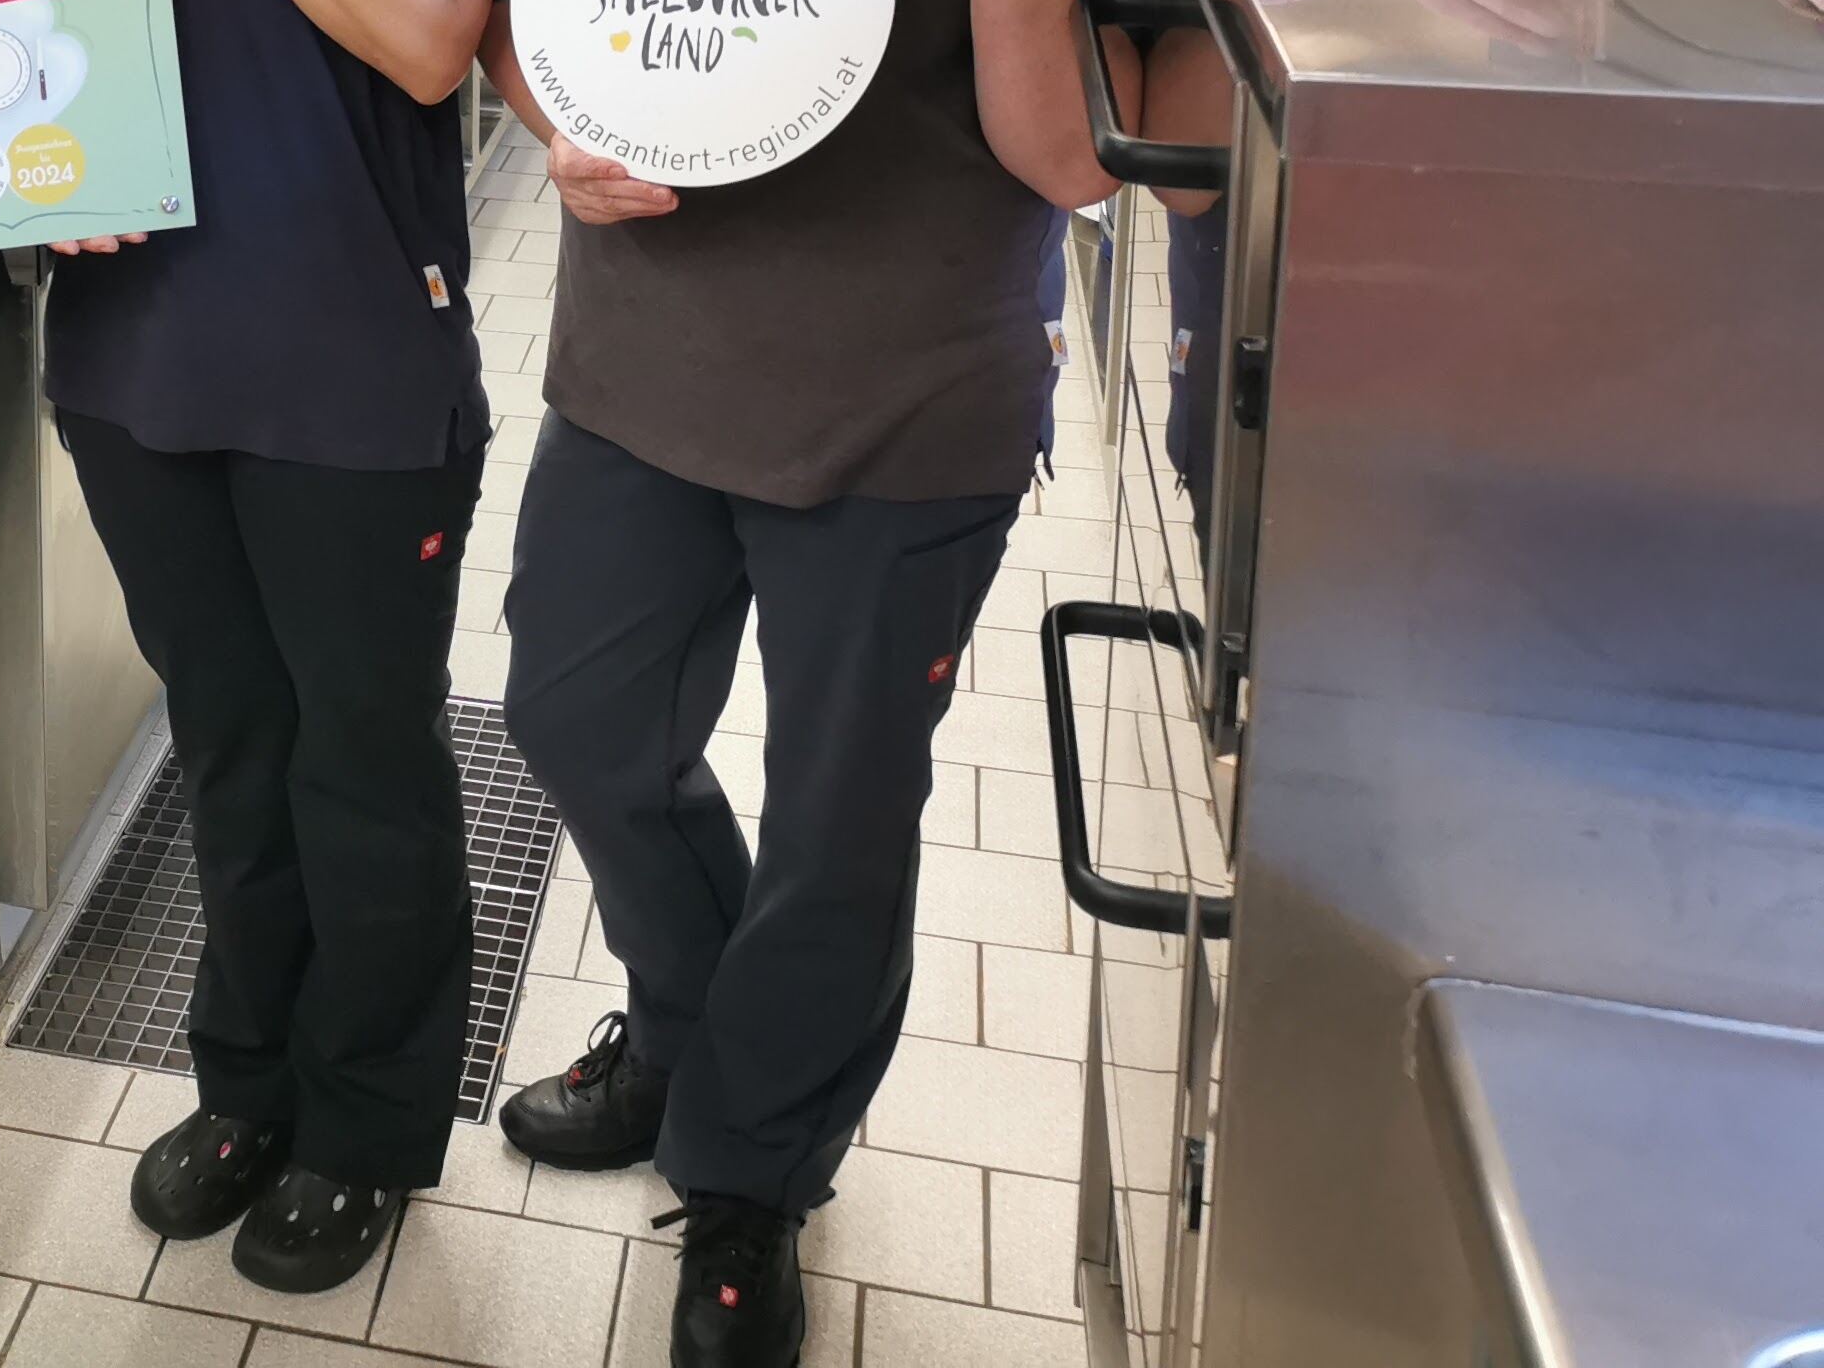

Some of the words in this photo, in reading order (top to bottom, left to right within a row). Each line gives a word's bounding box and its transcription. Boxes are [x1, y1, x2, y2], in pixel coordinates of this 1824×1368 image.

[640, 13, 725, 74] LAND
[529, 47, 864, 173] www.garantiert-regional.at
[16, 161, 76, 190] 2024
